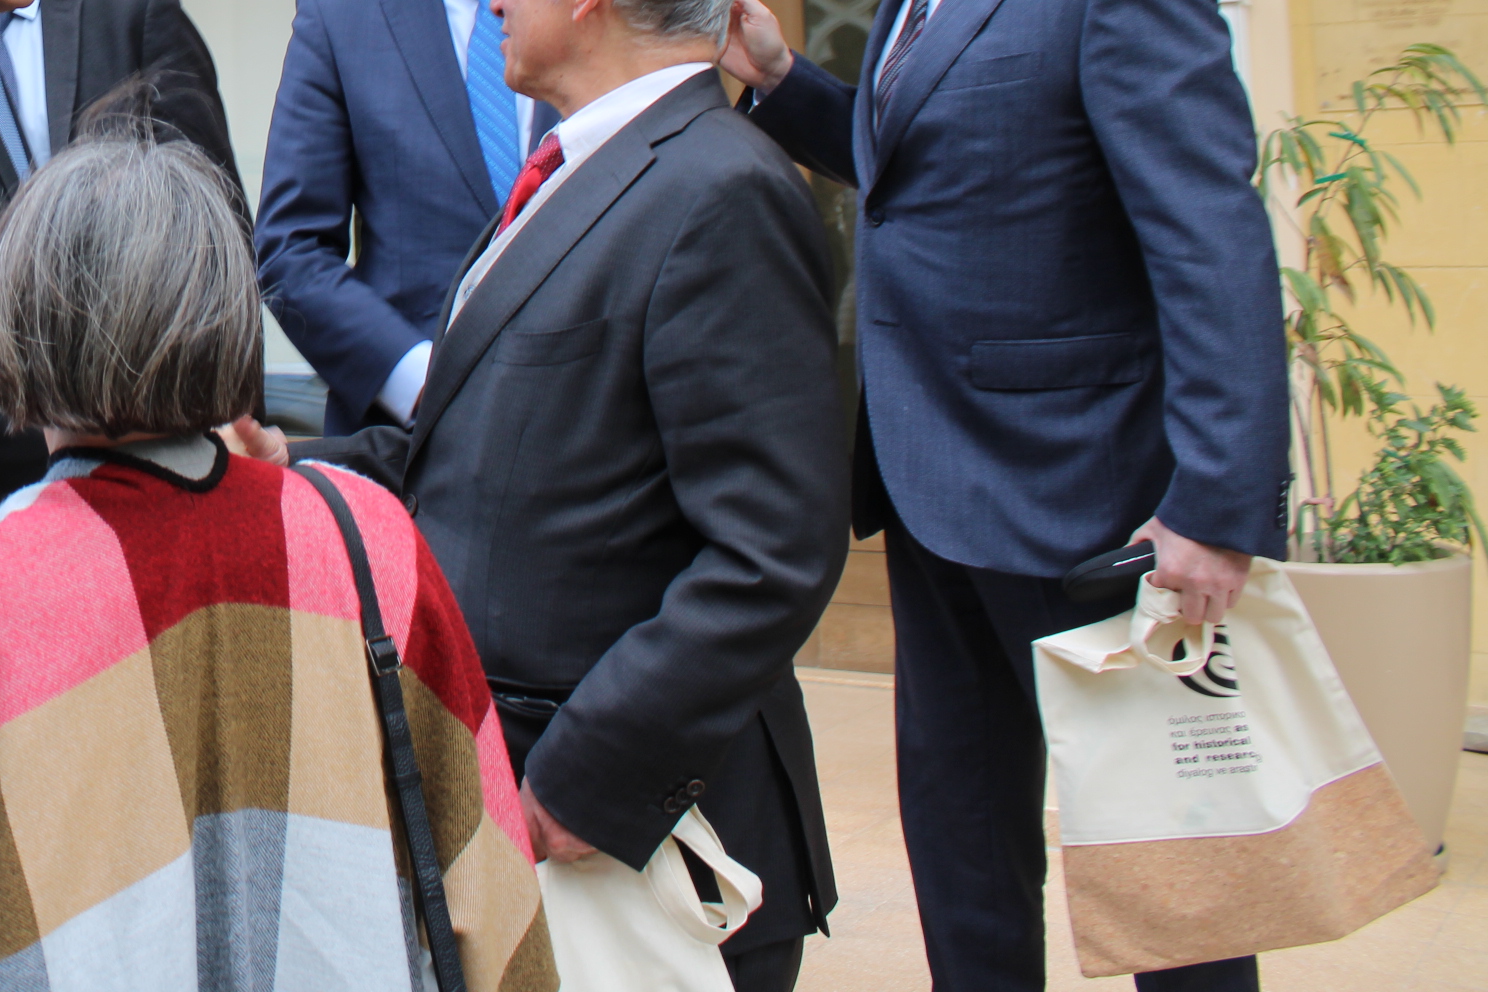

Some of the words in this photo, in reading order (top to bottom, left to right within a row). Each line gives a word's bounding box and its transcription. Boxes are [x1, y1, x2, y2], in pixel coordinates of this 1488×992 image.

[1170, 730, 1187, 738] και
[1171, 741, 1190, 751] for
[1194, 736, 1251, 750] historical
[1174, 754, 1200, 765] and
[1176, 767, 1214, 780] diyalog
[1217, 766, 1228, 775] ve
